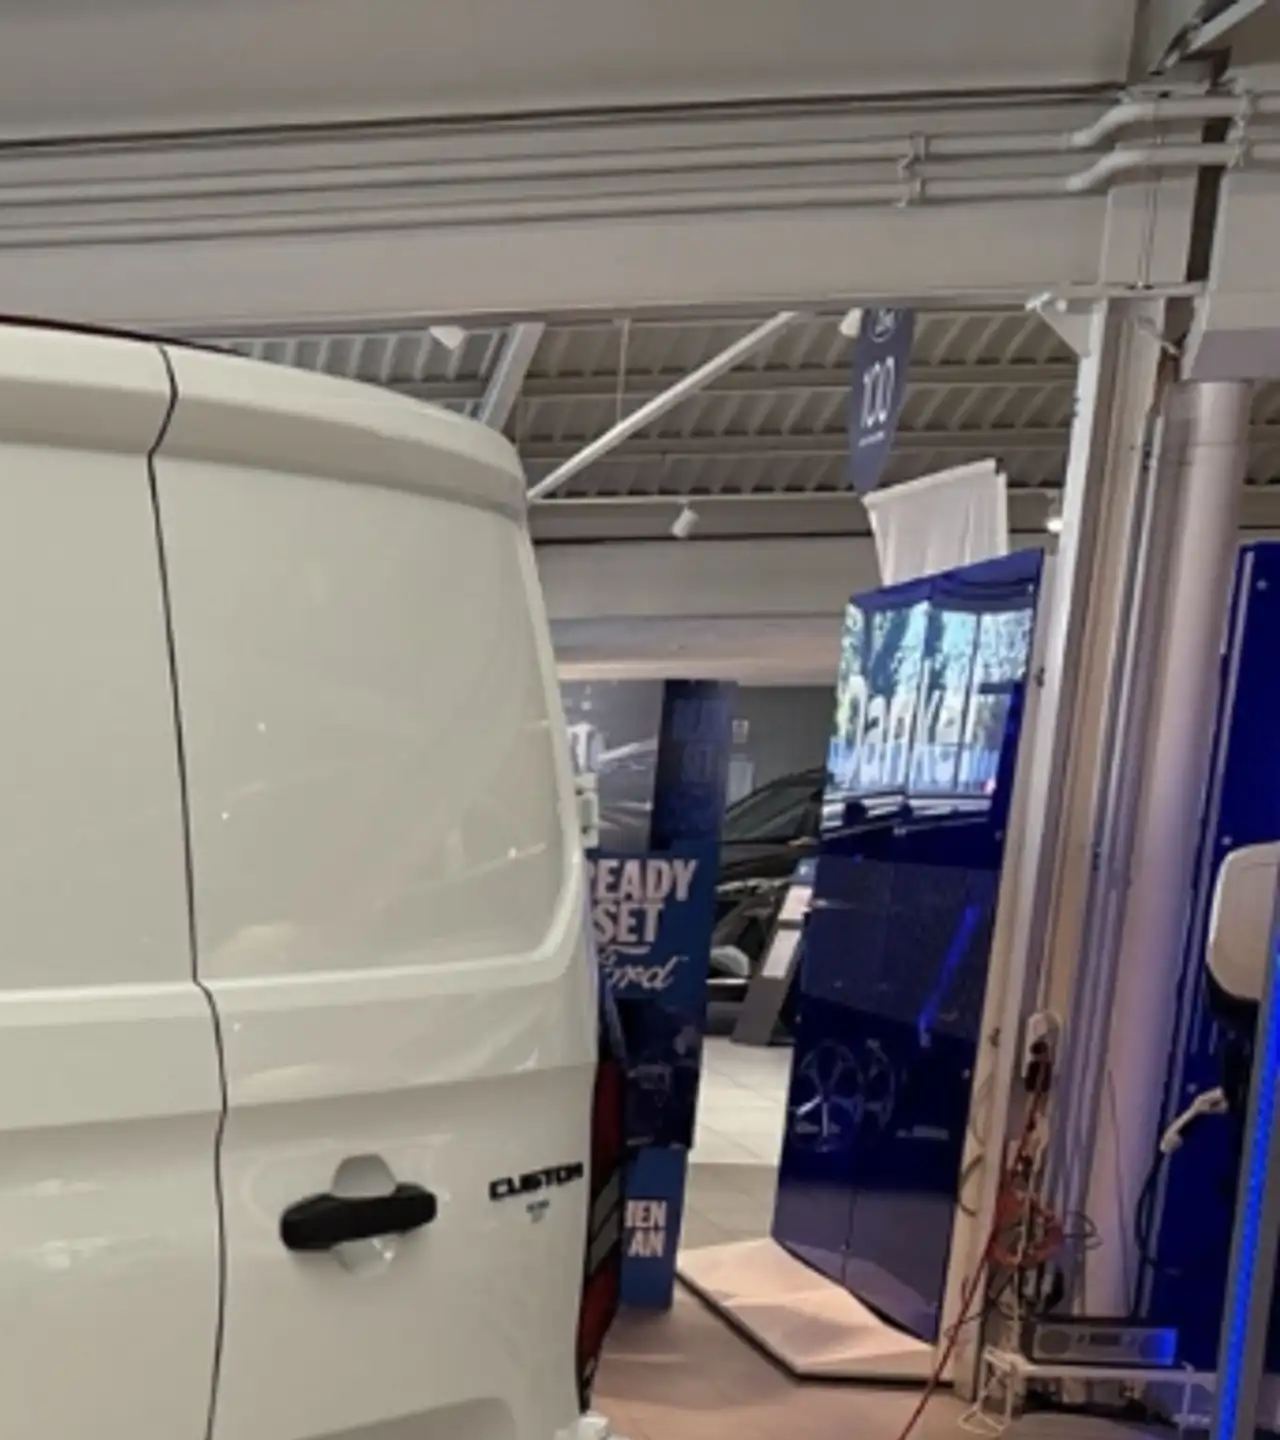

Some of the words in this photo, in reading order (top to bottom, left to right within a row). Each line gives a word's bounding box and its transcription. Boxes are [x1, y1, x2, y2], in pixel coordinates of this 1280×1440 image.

[588, 857, 699, 902] EADY
[593, 902, 665, 943] SET
[489, 1161, 584, 1201] CUSTOM
